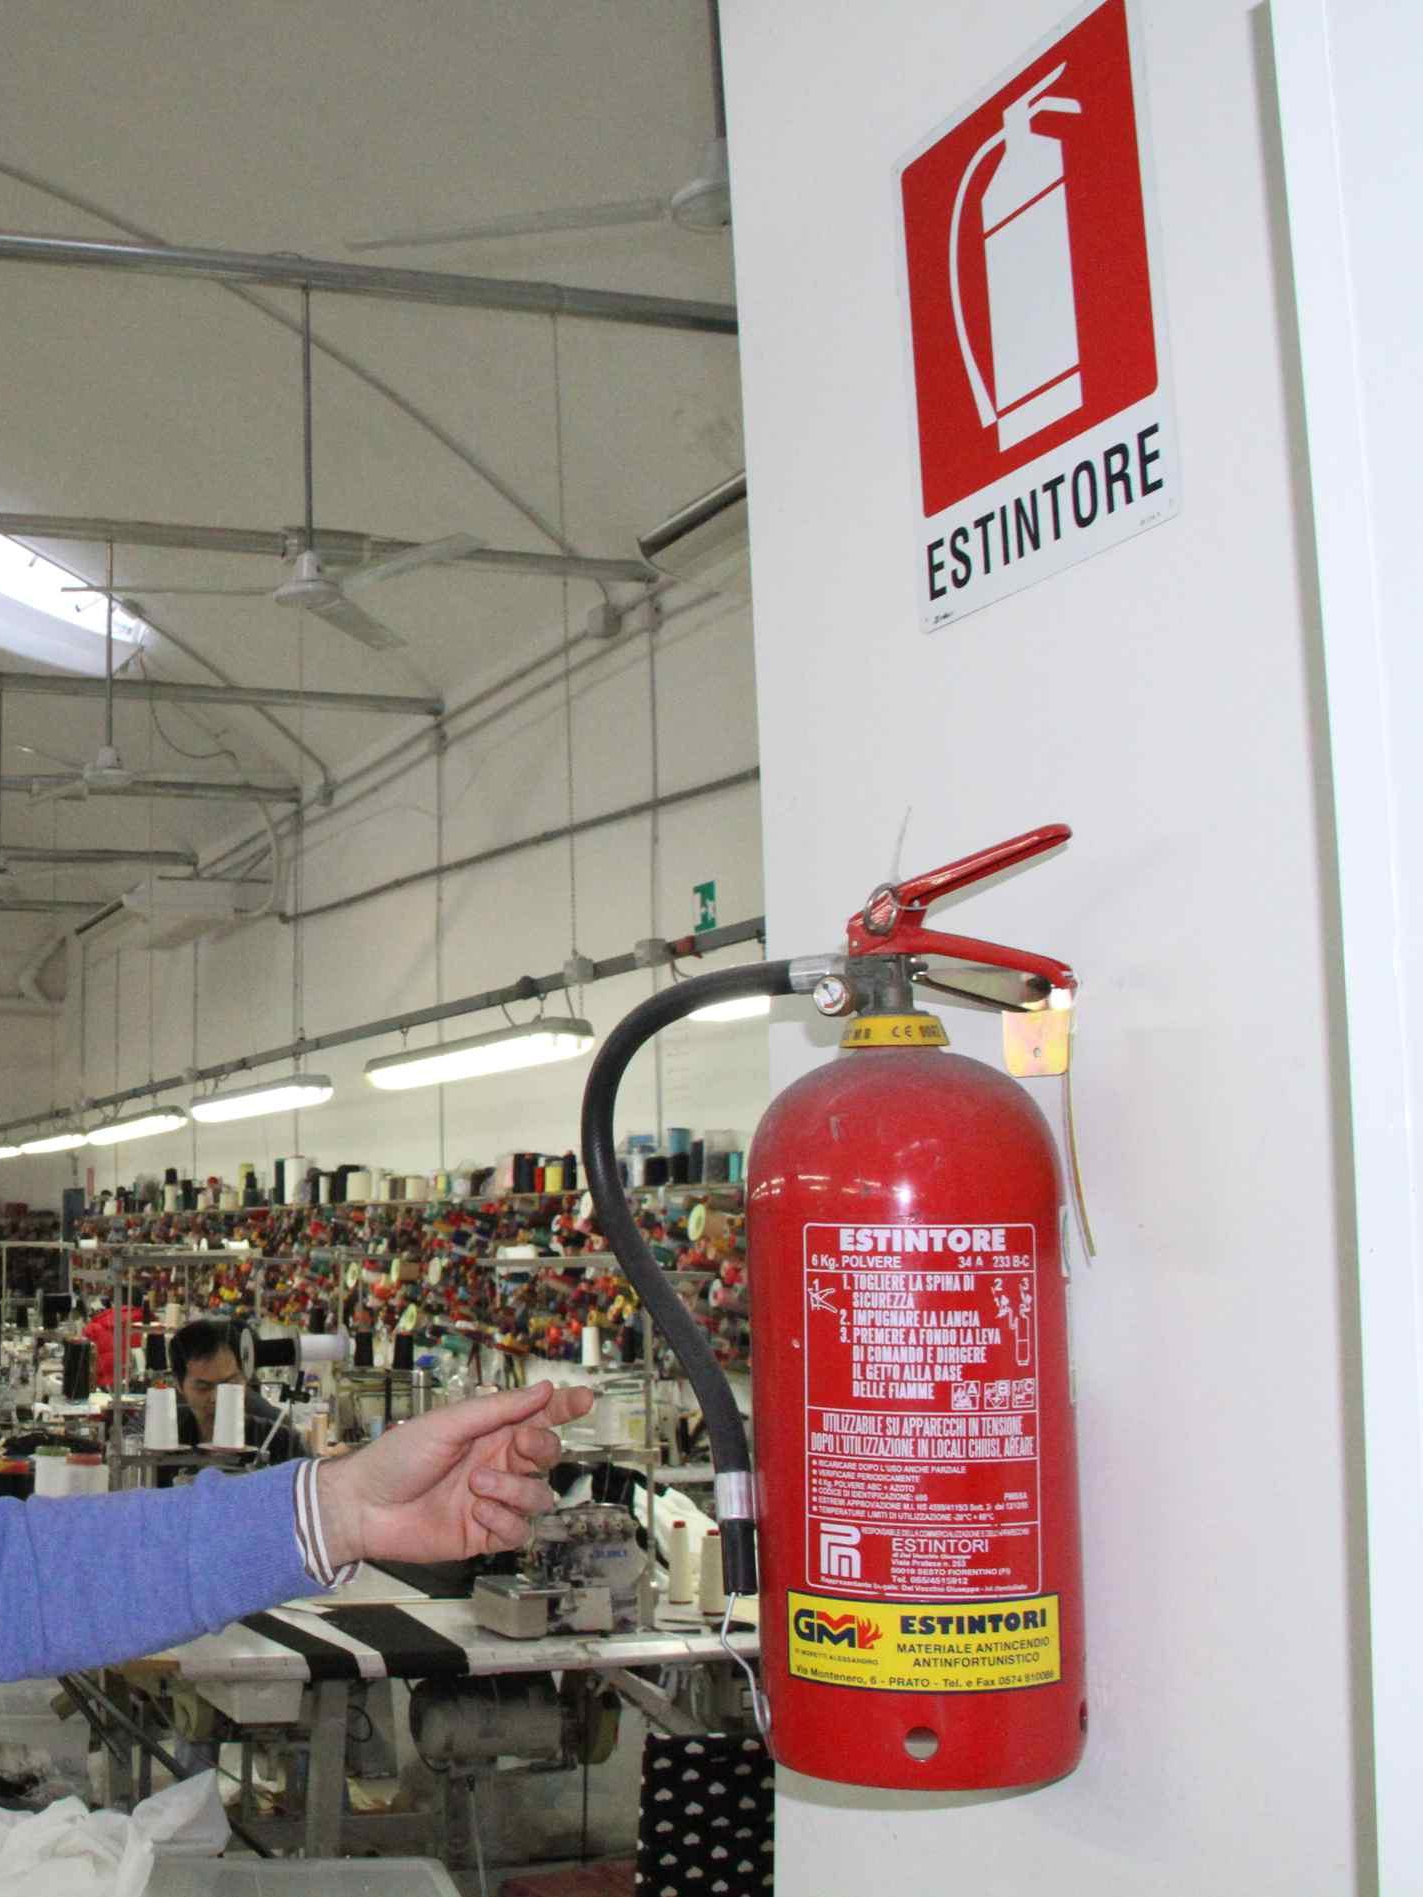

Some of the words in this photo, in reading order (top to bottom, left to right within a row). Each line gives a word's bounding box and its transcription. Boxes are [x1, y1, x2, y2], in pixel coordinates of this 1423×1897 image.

[926, 422, 1164, 601] ESTINTORE
[839, 1228, 1006, 1252] ESTINTORE
[811, 1254, 818, 1266] 6
[820, 1255, 839, 1269] Kg.
[841, 1255, 902, 1268] POLVERE
[958, 1256, 972, 1268] 34
[992, 1255, 1011, 1268] 233
[853, 1274, 906, 1291] TOGLIERE
[909, 1275, 923, 1291] LA
[926, 1275, 961, 1291] SPINA
[963, 1274, 975, 1291] DI
[852, 1292, 915, 1309] SICUREZZA
[853, 1310, 920, 1327] IMPUGNARE
[923, 1311, 938, 1327] LA
[940, 1311, 980, 1327] LANCIA
[853, 1328, 906, 1344] PREMERE
[908, 1328, 916, 1344] A
[919, 1328, 957, 1345] FONDO
[959, 1328, 973, 1345] LA
[975, 1328, 1001, 1344] LEVA
[852, 1345, 864, 1362] DI
[867, 1346, 923, 1363] COMANDO
[926, 1347, 934, 1363] E
[936, 1346, 987, 1363] DIRIGERE
[852, 1363, 862, 1379] IL
[865, 1364, 900, 1381] GETTO
[903, 1364, 932, 1381] ALLA
[934, 1364, 963, 1381] BASE
[852, 1381, 886, 1398] DELLE
[888, 1382, 934, 1399] FIAMME
[823, 1412, 883, 1435] UTILIZZABILE
[886, 1416, 900, 1435] SU
[903, 1417, 966, 1437] APPARECCHI
[968, 1417, 979, 1437] IN
[981, 1416, 1023, 1436] TENSIONE
[811, 1432, 835, 1452] DOPO
[836, 1434, 915, 1457] L'UTILIZZAZIONE
[917, 1438, 929, 1457] IN
[931, 1438, 967, 1458] LOCALI
[1004, 1436, 1034, 1456] AREARE
[818, 1460, 857, 1470] RICARICARE
[858, 1463, 879, 1471] DOPO
[903, 1465, 929, 1473] ANCHE
[930, 1465, 967, 1474] PARZIALE
[857, 1472, 921, 1483] PERIODICAMENTE
[892, 1538, 989, 1553] ESTINTORI
[900, 1608, 1047, 1635] ESTINTORI
[897, 1643, 974, 1654] MATERIALE
[976, 1636, 1050, 1653] ANTINCENDIO
[913, 1651, 1040, 1668] ANTINFORTUNISTICO
[889, 1677, 929, 1688] PRATO
[943, 1678, 962, 1687] Tel.
[976, 1677, 995, 1687] Fax
[998, 1674, 1022, 1685] 0574
